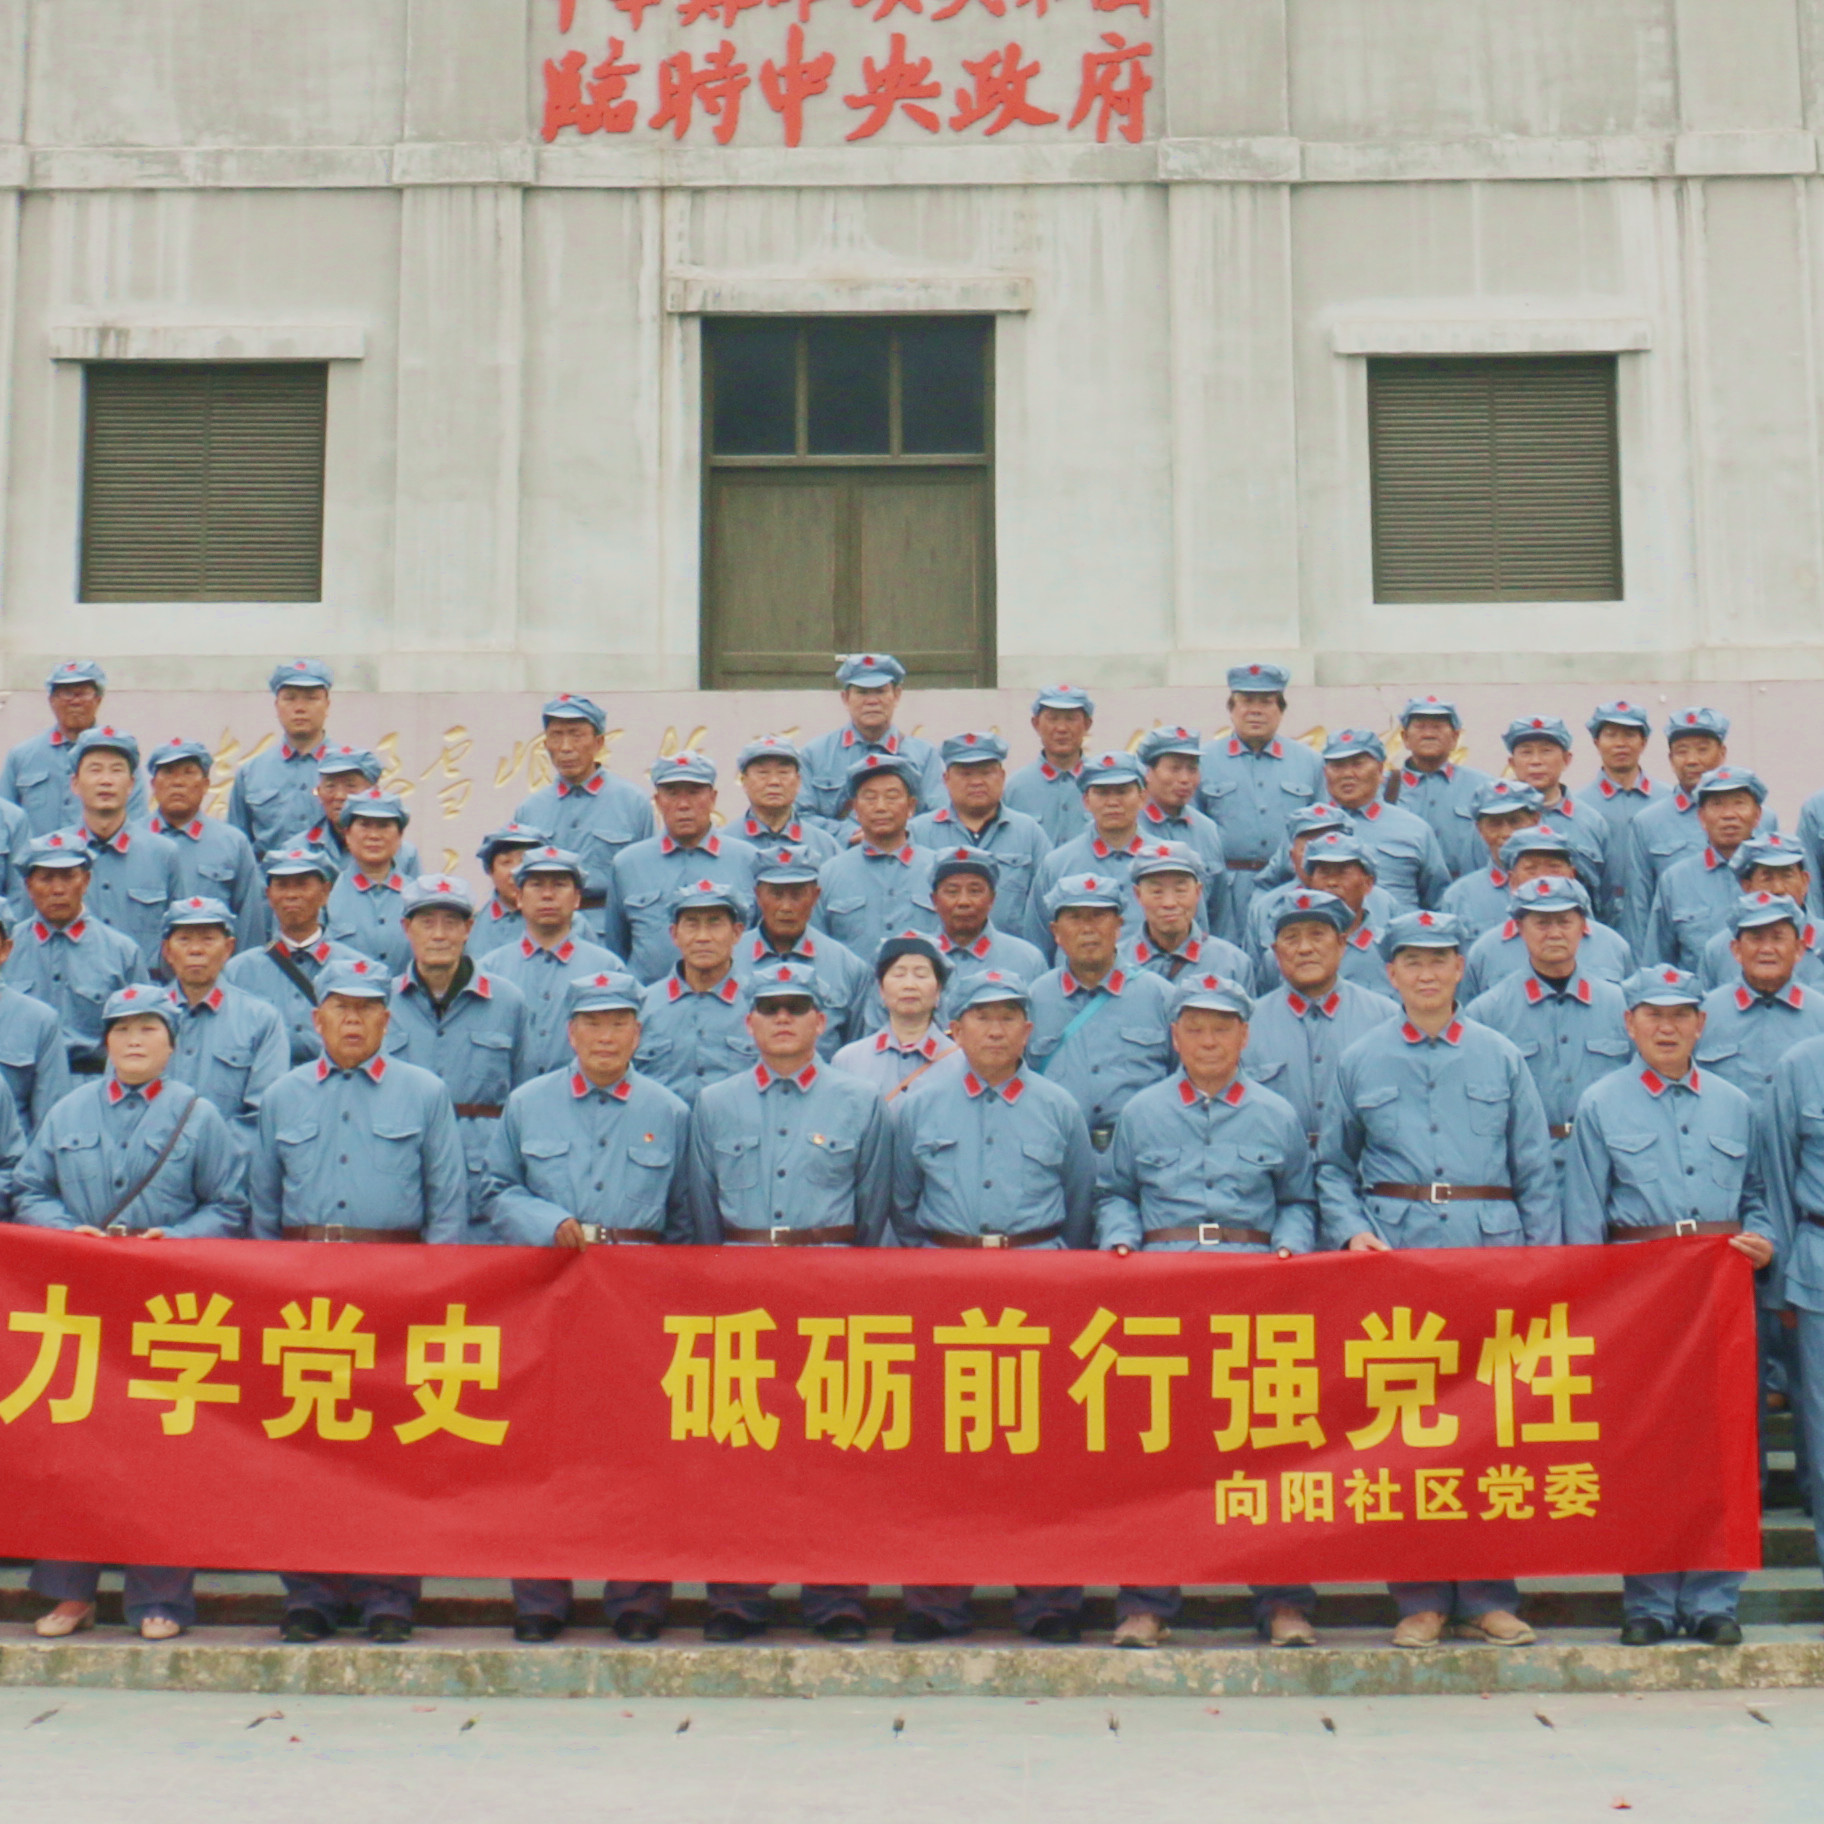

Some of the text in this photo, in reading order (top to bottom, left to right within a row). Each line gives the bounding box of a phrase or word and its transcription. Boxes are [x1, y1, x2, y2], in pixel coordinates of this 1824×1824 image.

[541, 24, 1153, 147] 臨時中央政府
[661, 1303, 1600, 1454] 砥砺前行强党性
[1215, 1462, 1600, 1525] 向阳社区党委
